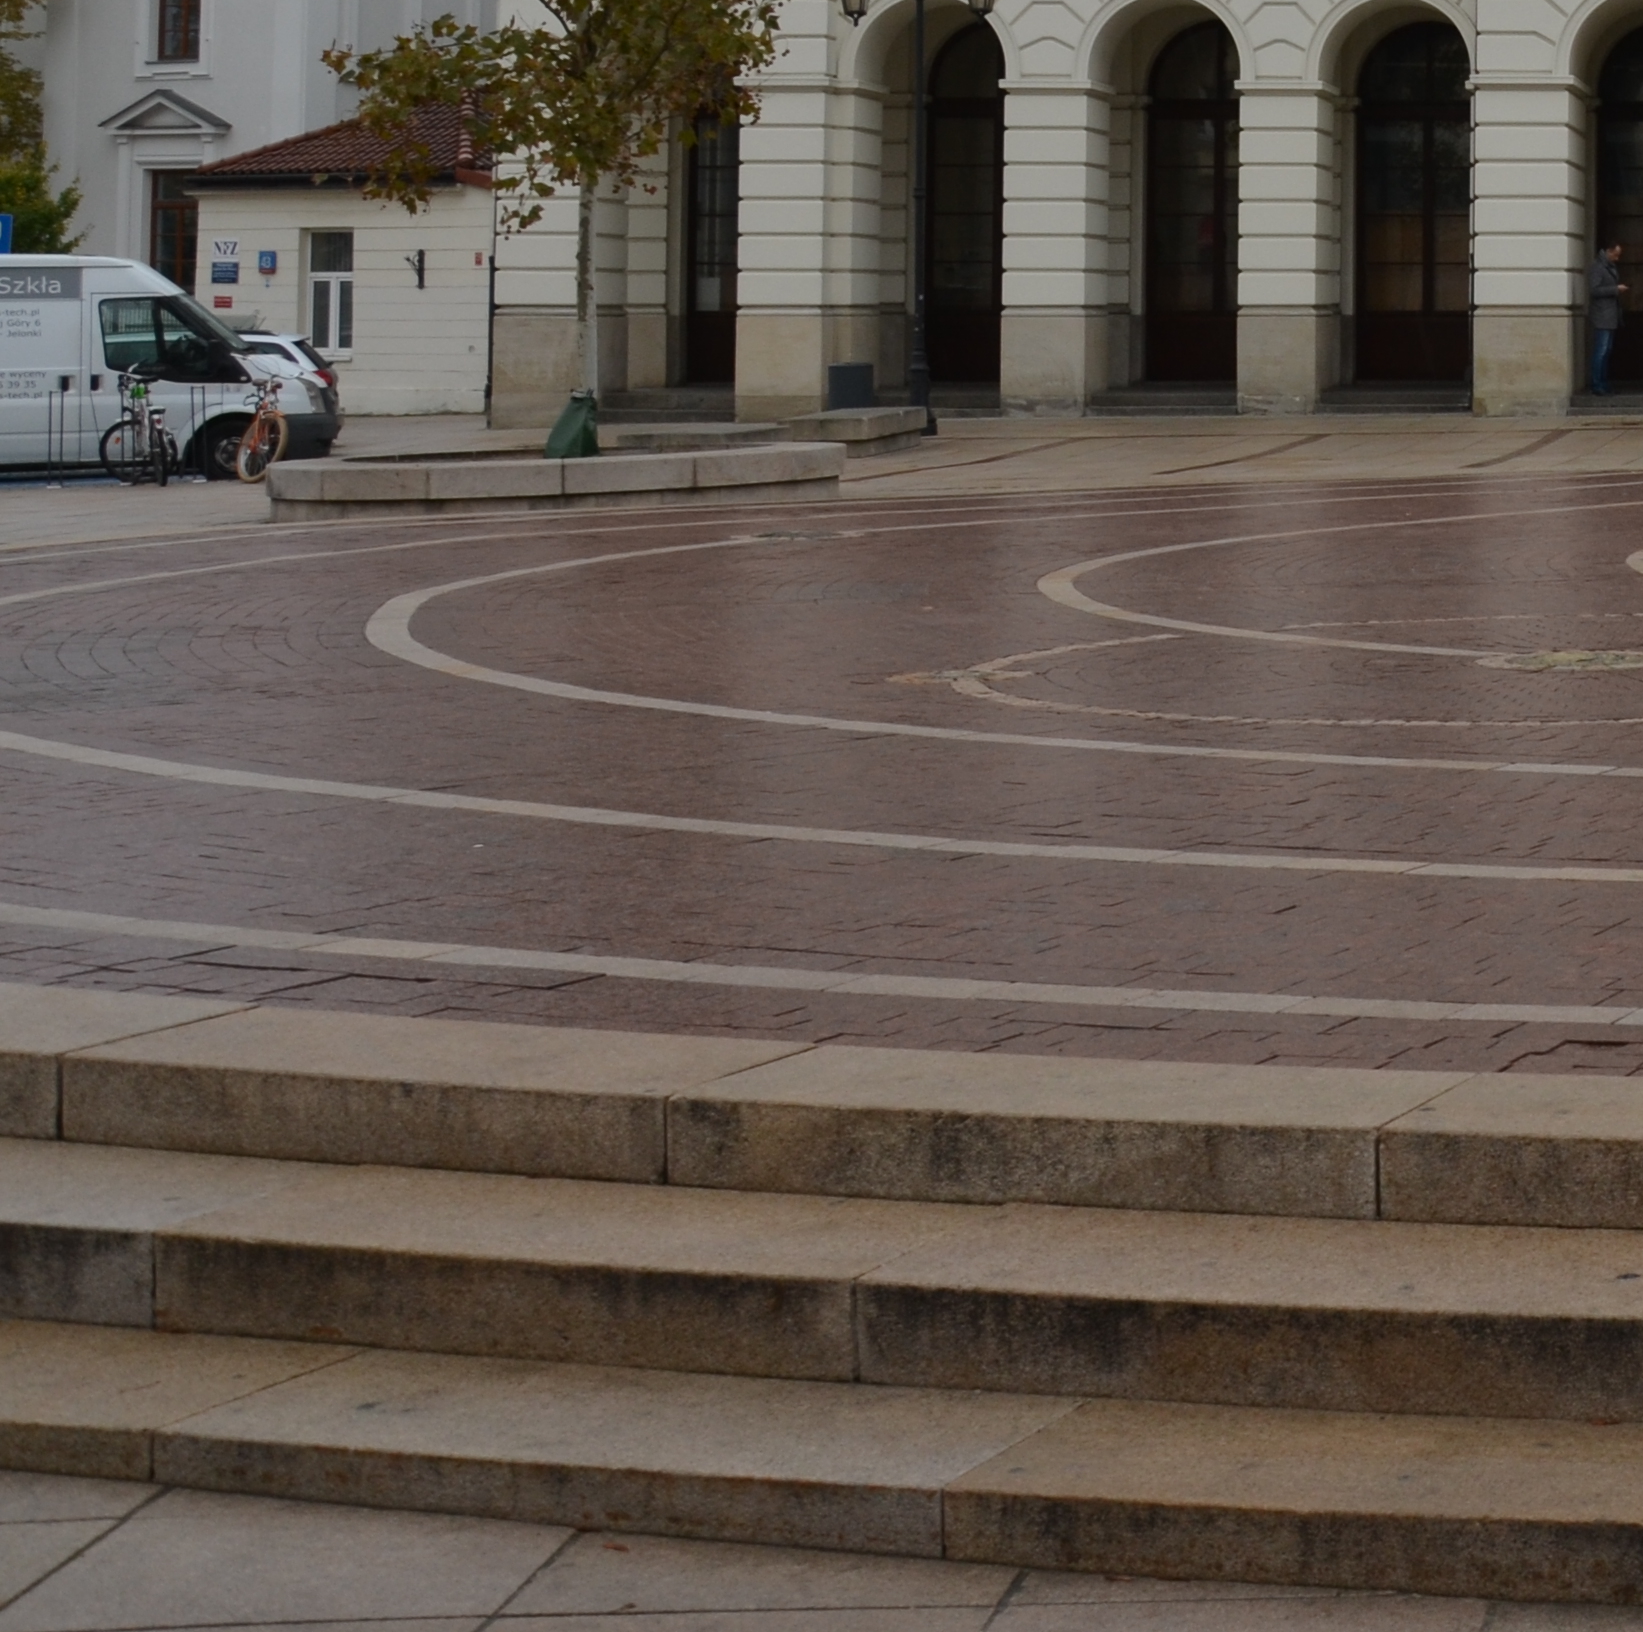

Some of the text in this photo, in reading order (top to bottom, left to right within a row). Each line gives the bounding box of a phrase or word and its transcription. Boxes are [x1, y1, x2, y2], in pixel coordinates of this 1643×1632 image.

[214, 241, 238, 255] NFZ
[0, 276, 62, 294] Szkła
[0, 309, 40, 319] -tech.pl
